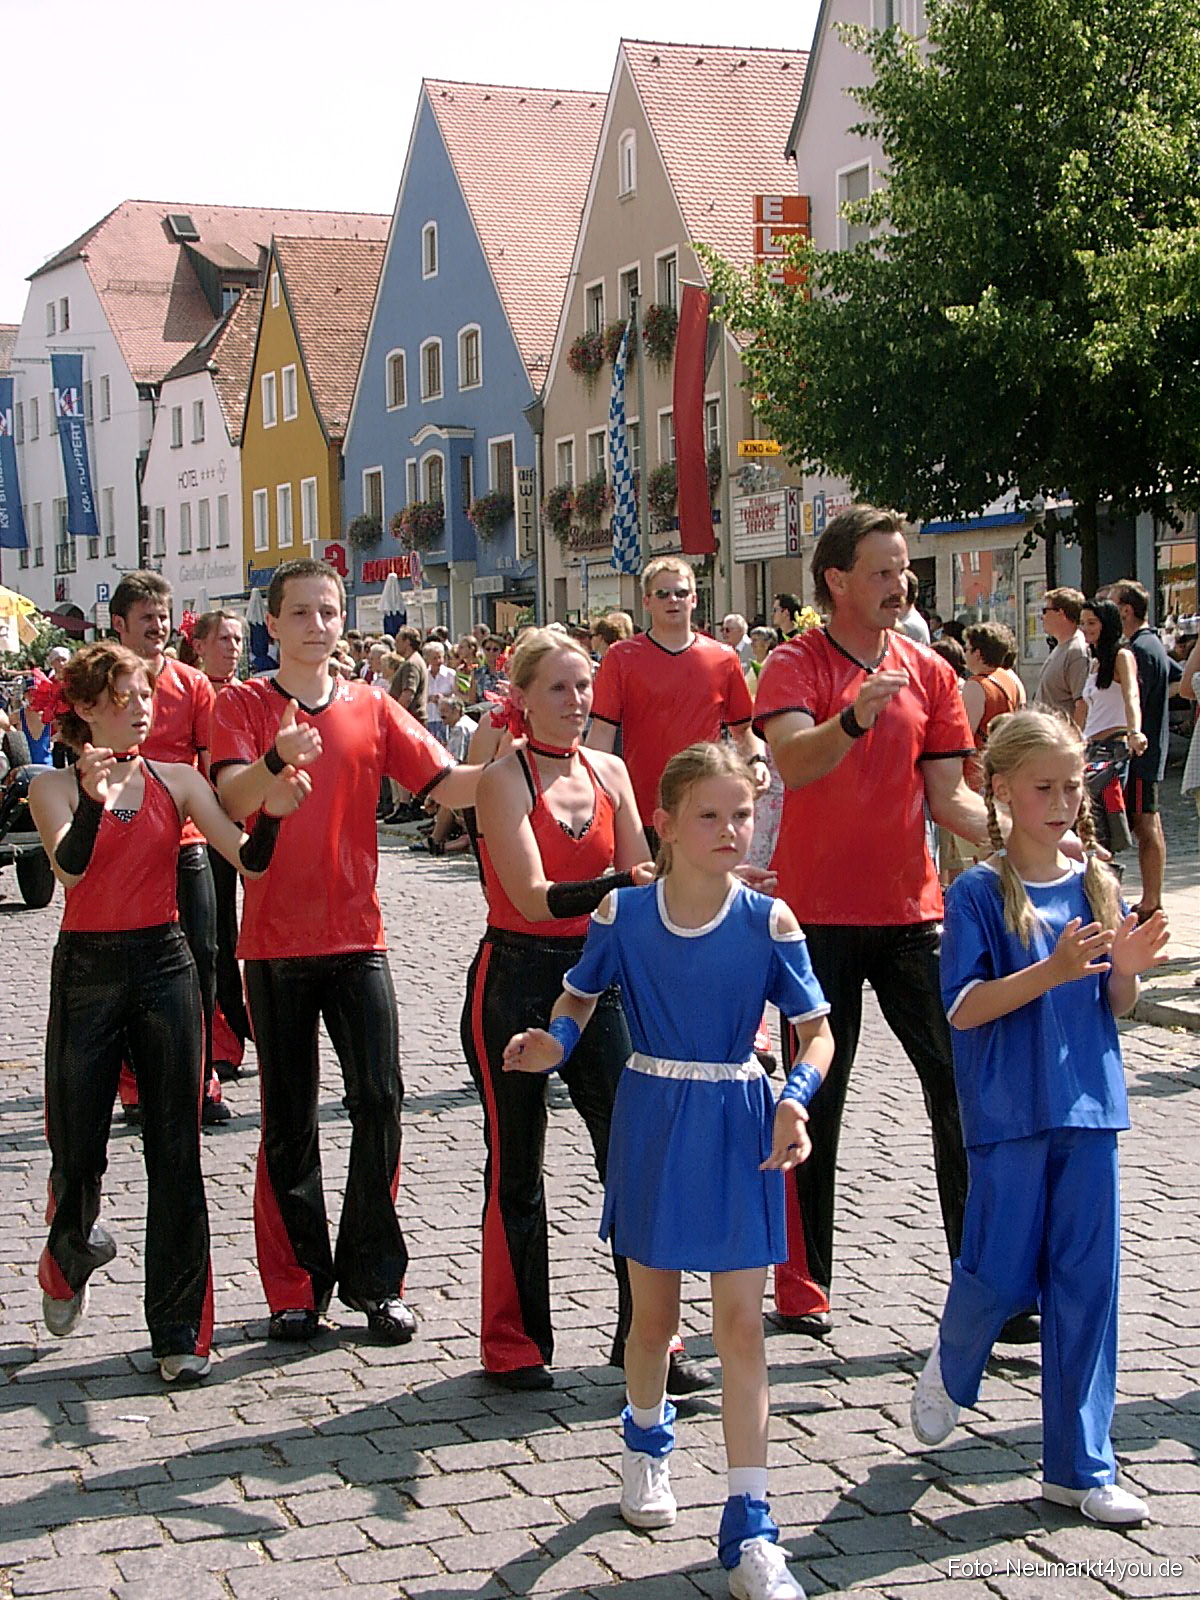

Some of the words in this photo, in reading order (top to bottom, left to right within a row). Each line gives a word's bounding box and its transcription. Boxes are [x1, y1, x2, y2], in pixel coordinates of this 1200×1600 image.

[744, 444, 764, 453] KINO
[178, 469, 199, 490] HOTEL
[519, 484, 534, 551] WITTL
[788, 491, 797, 552] KINO
[362, 555, 412, 583] APOTHEK
[99, 585, 107, 602] P
